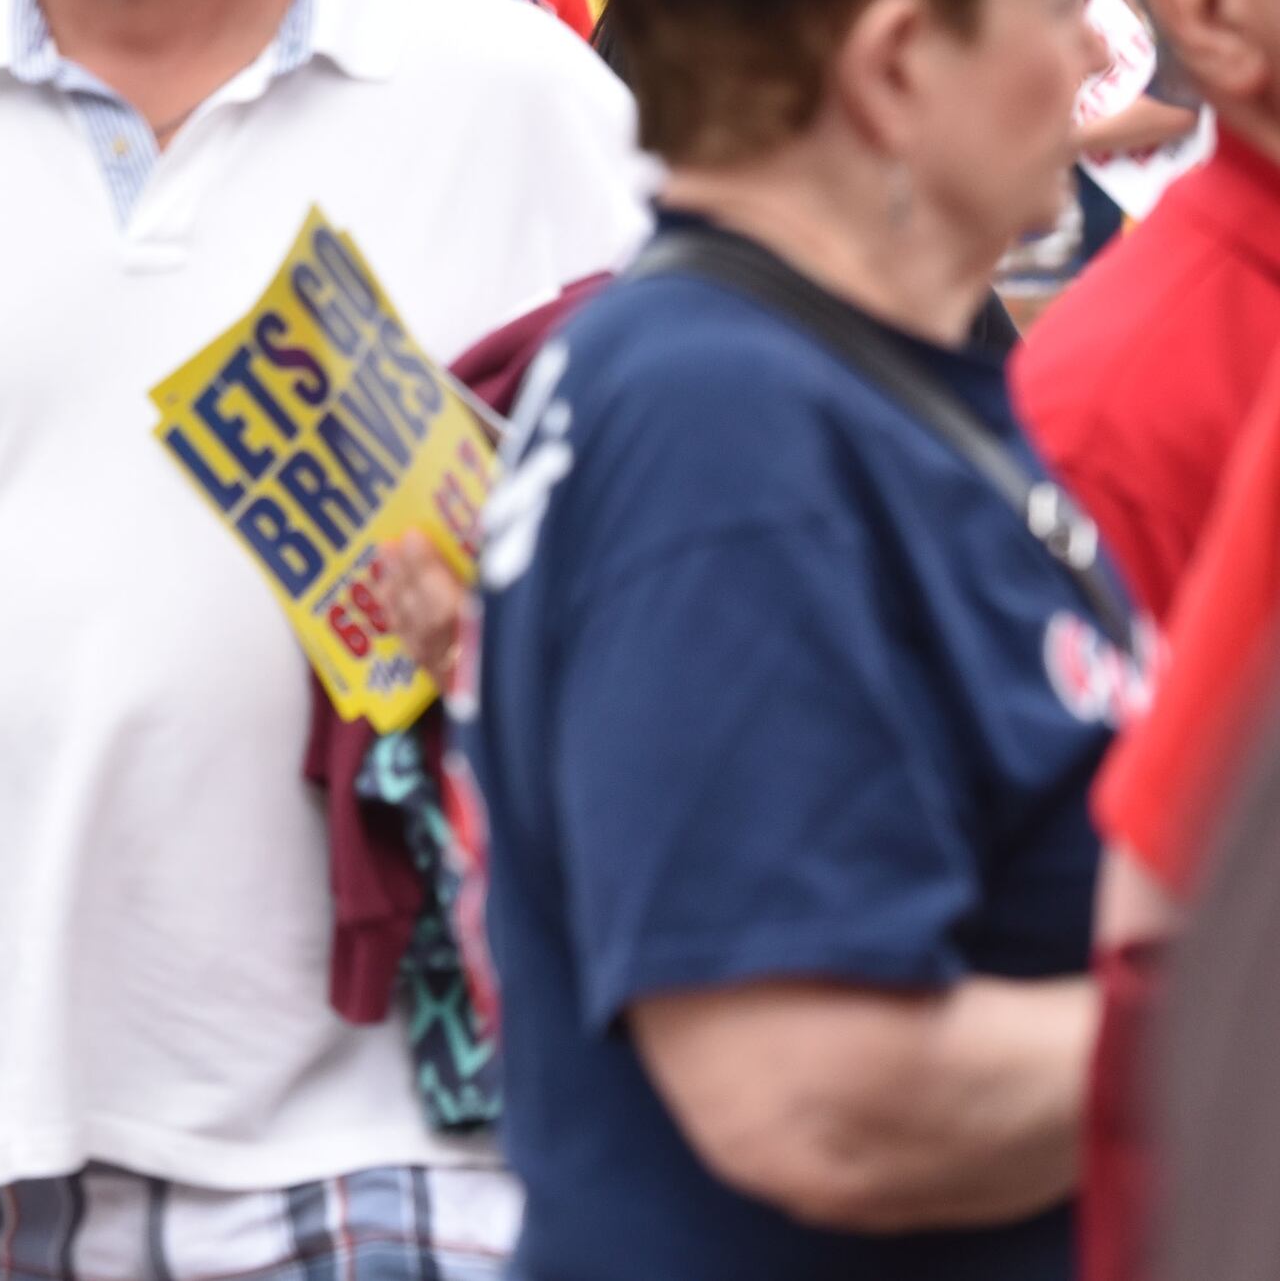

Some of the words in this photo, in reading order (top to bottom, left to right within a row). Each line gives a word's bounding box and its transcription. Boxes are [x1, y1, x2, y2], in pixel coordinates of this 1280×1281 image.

[162, 310, 332, 515] LETS
[290, 226, 380, 359] GO
[235, 311, 444, 602] BRAVES
